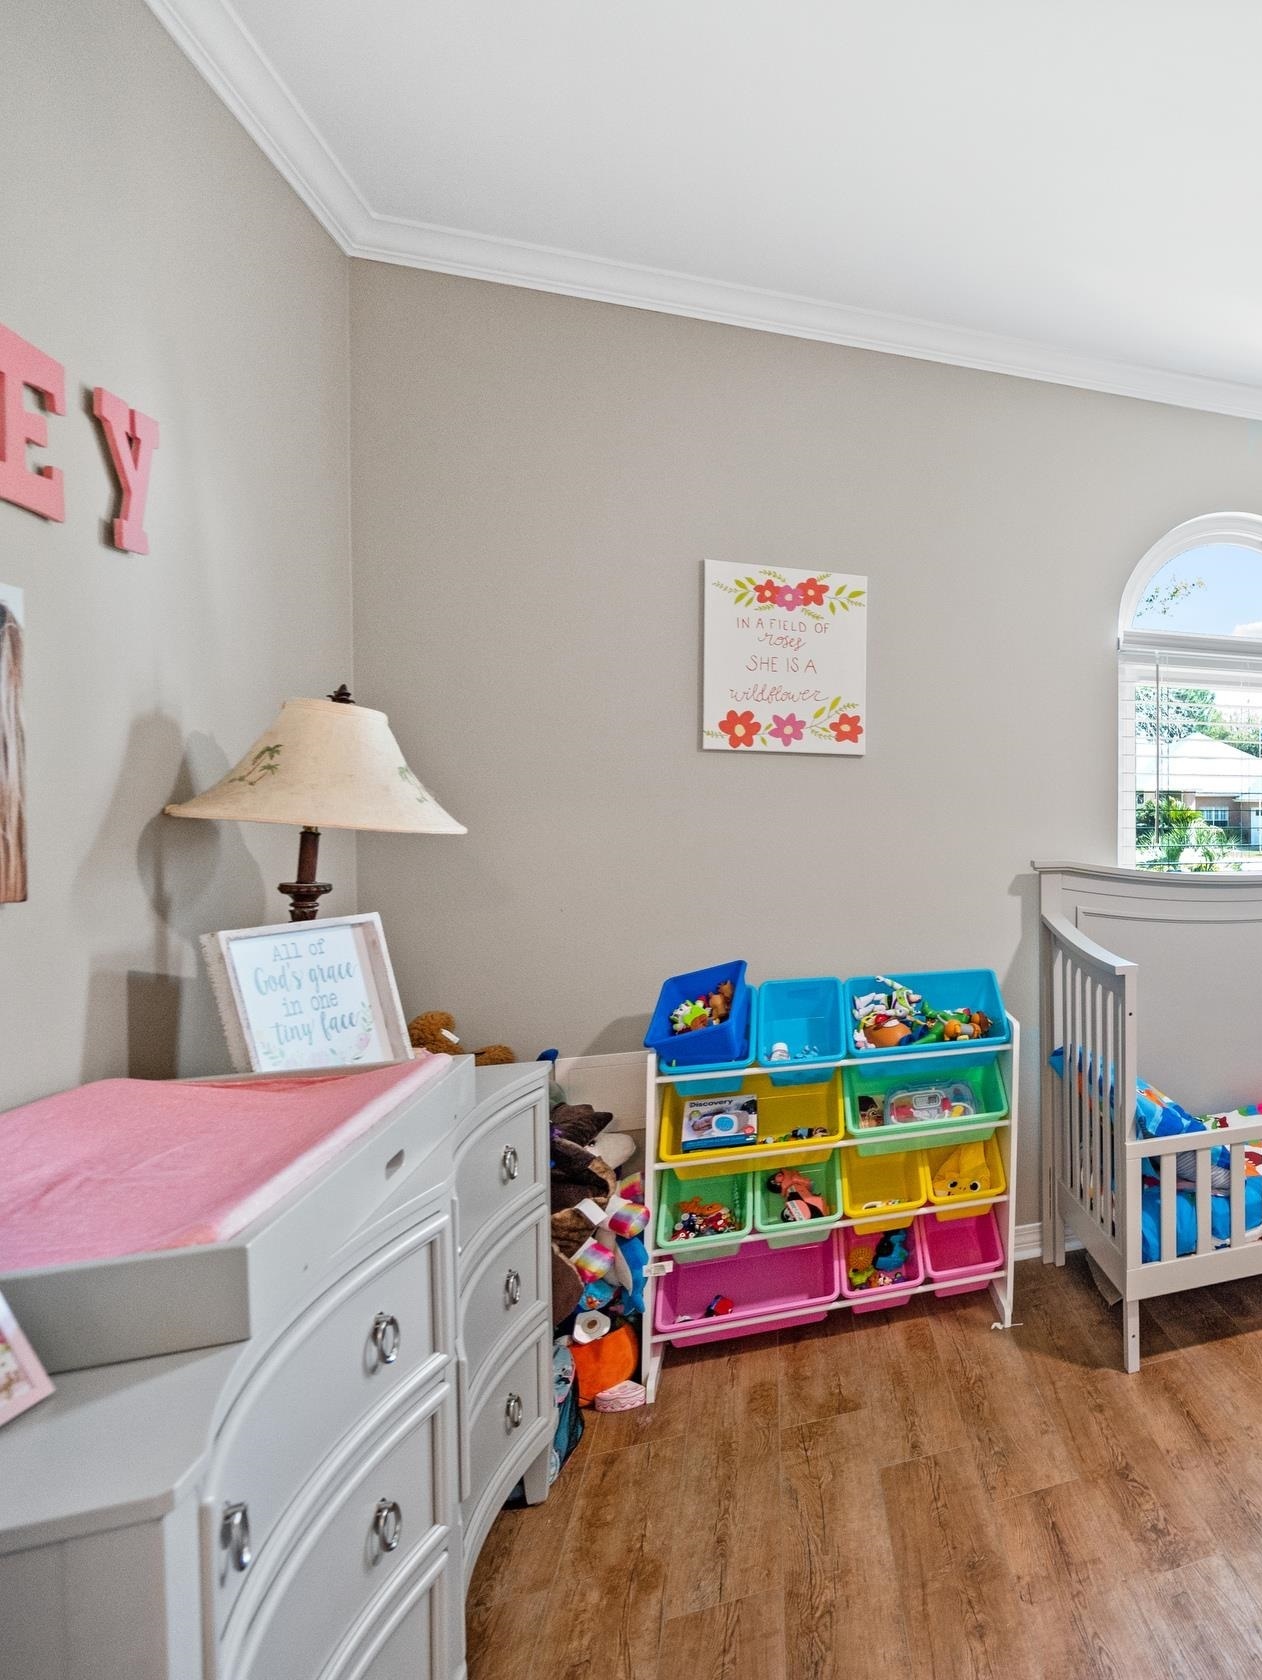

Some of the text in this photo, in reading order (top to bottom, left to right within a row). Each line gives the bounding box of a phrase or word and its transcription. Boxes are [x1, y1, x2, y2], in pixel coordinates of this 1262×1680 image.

[736, 617, 830, 635] IN A FIELD OF
[757, 632, 806, 651] roses
[745, 655, 817, 674] SHE IS A
[729, 684, 829, 704] wildflower
[273, 938, 325, 962] All of
[254, 962, 355, 996] God's grace
[281, 993, 339, 1017] in one
[269, 1011, 358, 1047] tiny face
[689, 1099, 733, 1108] Discovery
